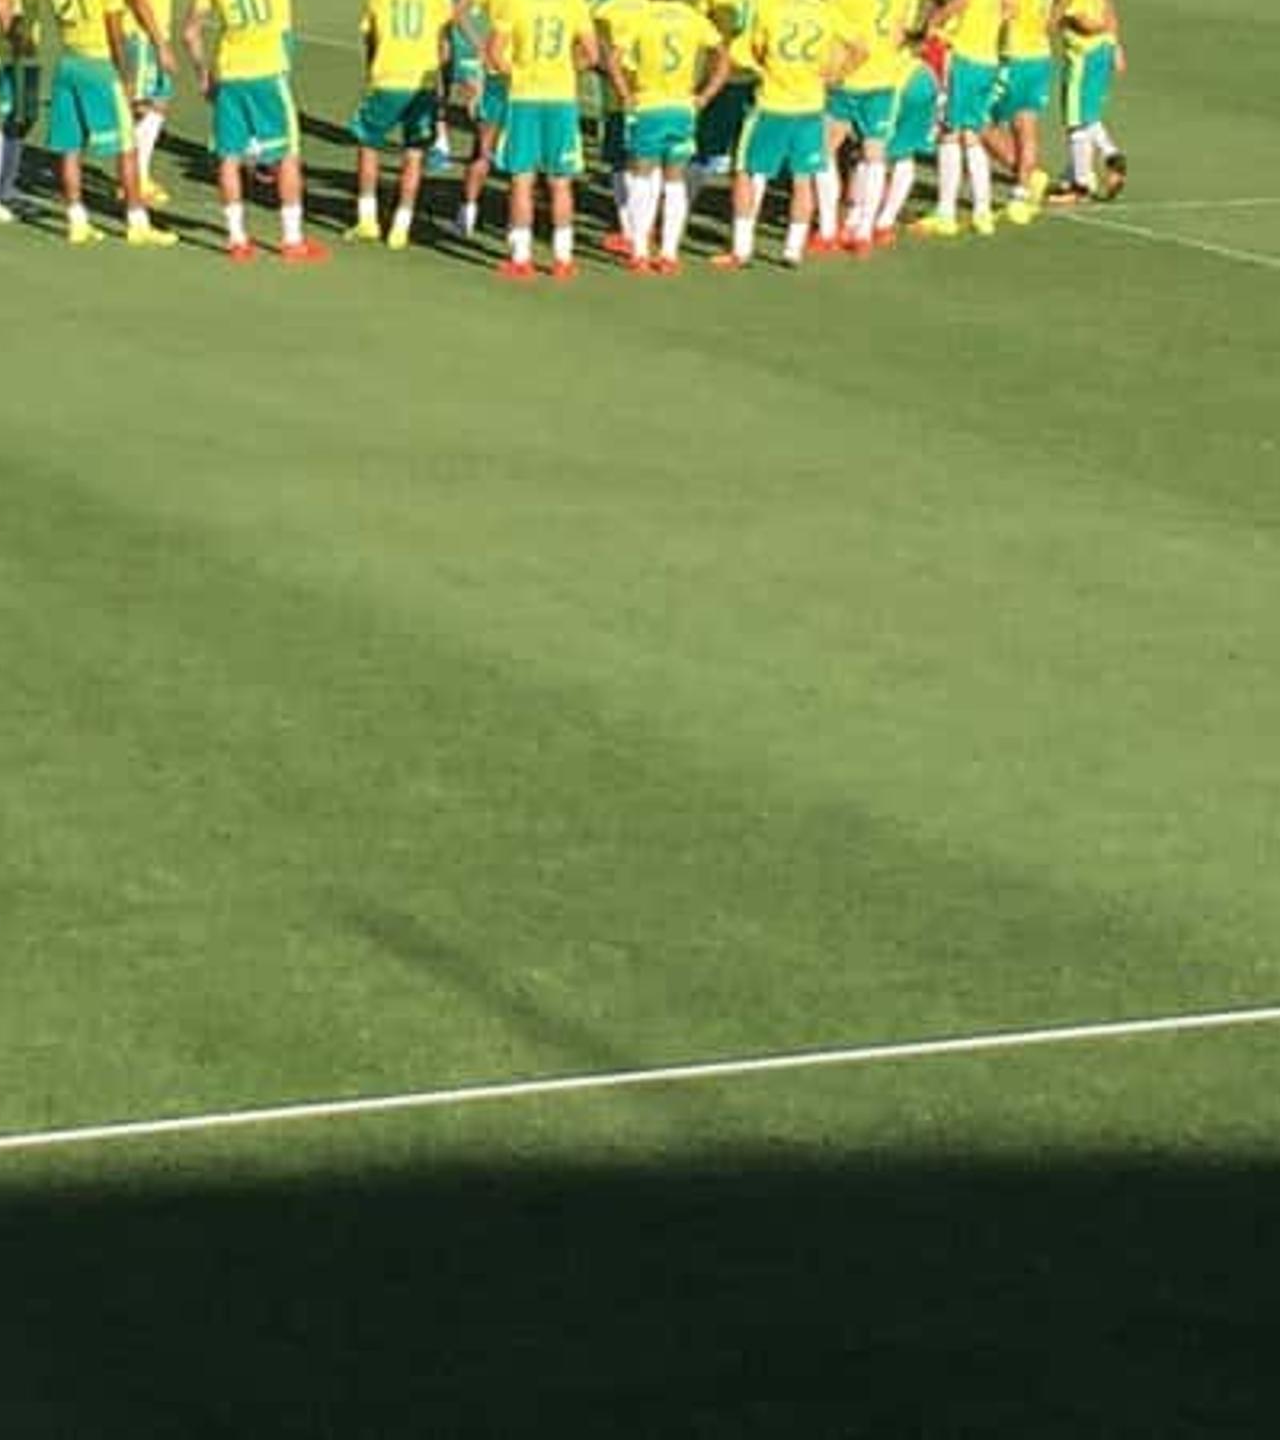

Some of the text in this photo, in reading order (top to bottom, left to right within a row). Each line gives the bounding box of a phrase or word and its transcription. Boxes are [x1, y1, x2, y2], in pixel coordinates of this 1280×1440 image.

[534, 16, 564, 61] 13
[663, 32, 683, 73] 5
[778, 18, 822, 62] 22
